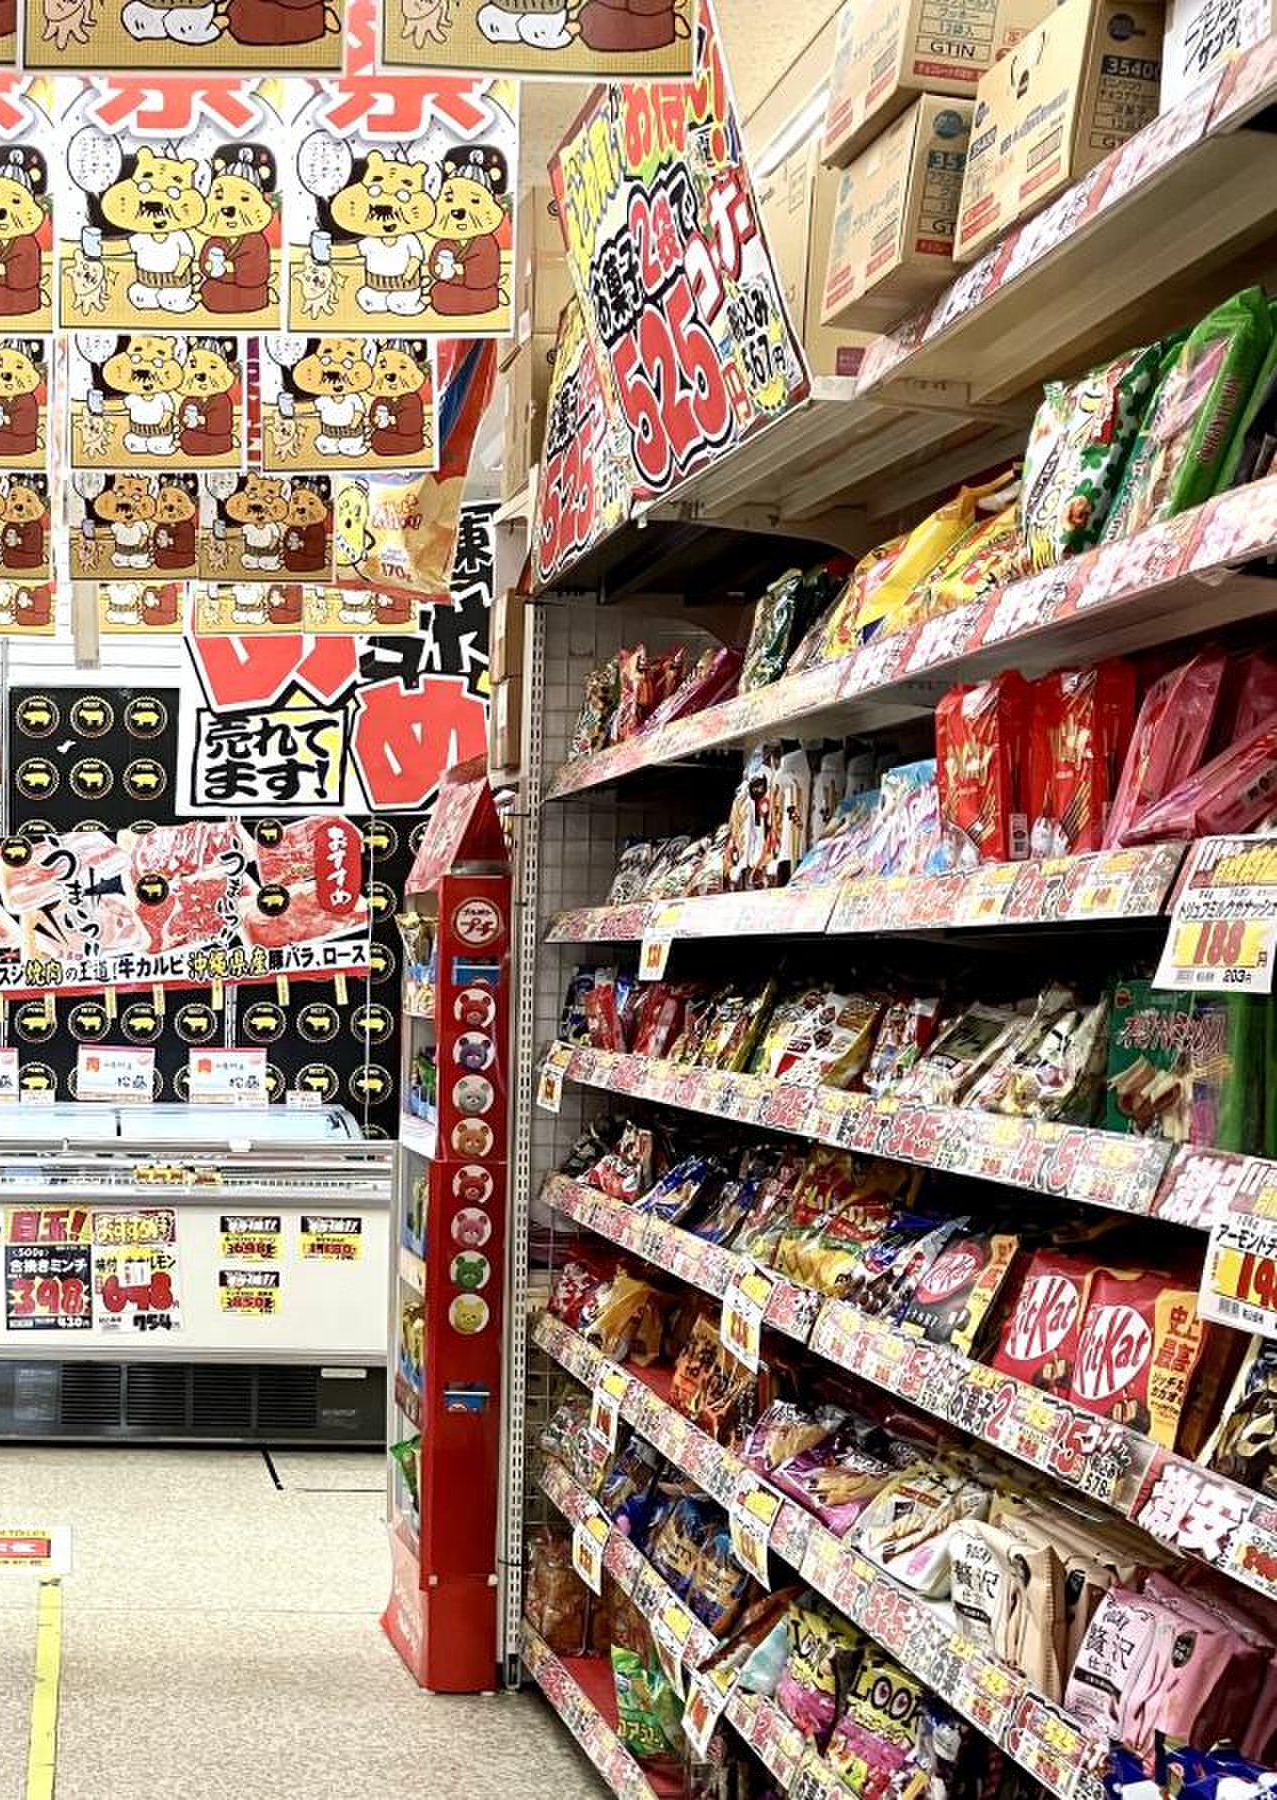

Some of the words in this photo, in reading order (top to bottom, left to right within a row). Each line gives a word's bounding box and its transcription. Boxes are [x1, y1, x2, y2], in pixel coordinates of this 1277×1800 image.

[930, 41, 976, 58] GTIN
[205, 716, 340, 760] 売れて
[204, 759, 330, 801] ます!
[325, 826, 353, 906] おすすめ
[10, 1209, 88, 1243] 目玉!
[11, 1279, 85, 1315] 398
